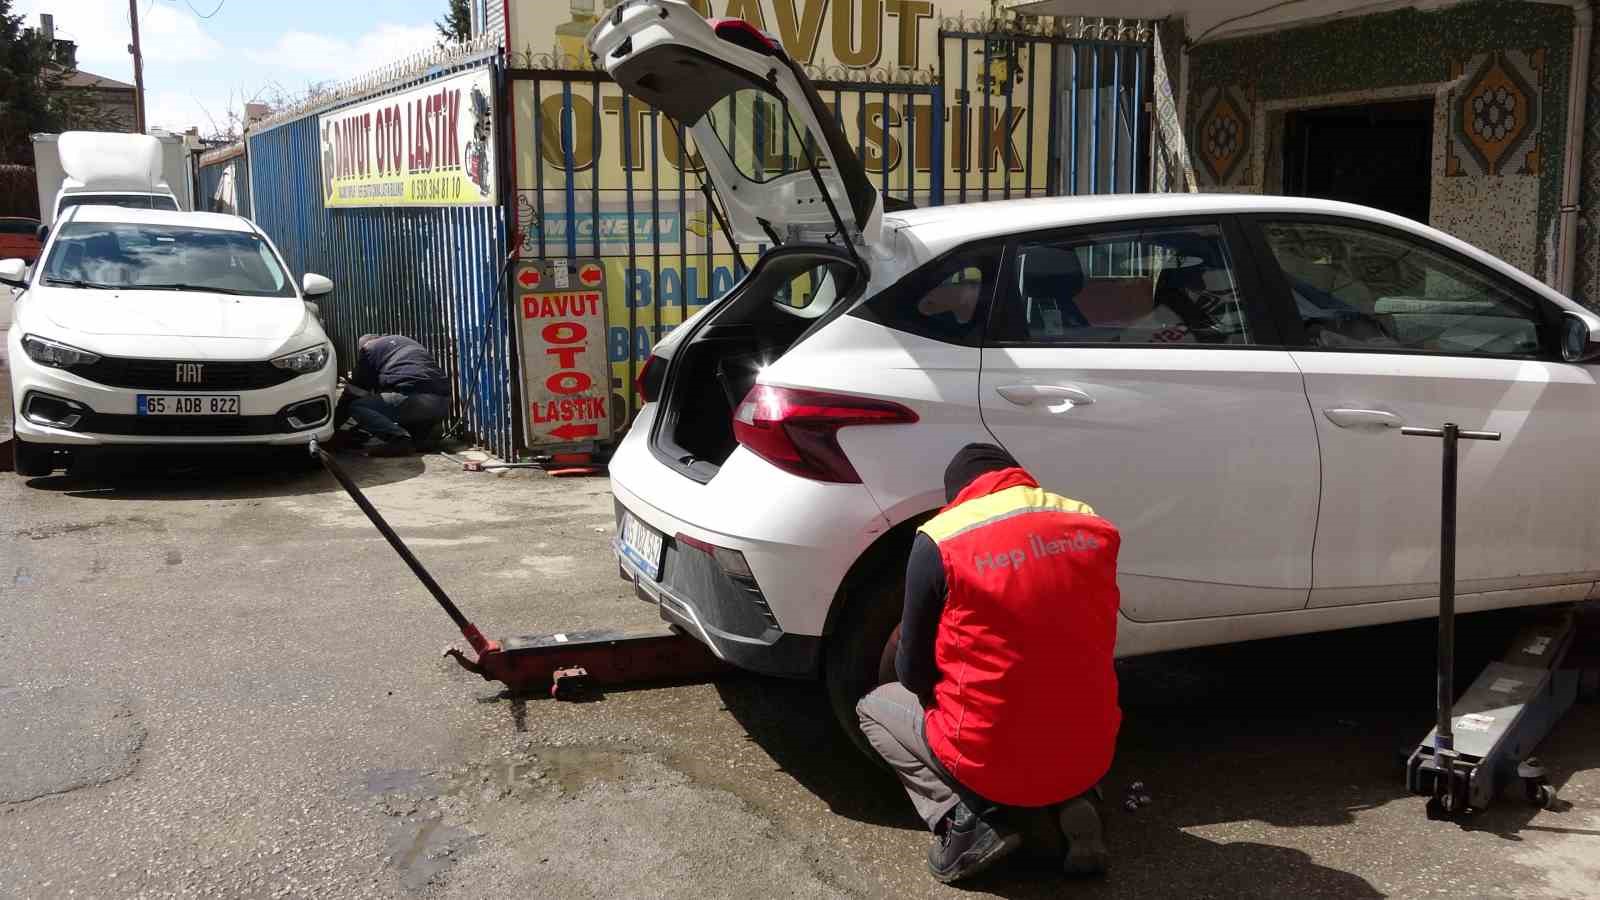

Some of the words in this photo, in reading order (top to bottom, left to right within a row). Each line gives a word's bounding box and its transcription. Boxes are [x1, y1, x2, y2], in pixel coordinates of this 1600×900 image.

[690, 0, 932, 69] VUT
[335, 112, 370, 180] DAVUT
[376, 104, 402, 178] OTO
[408, 86, 461, 175] LASTİK
[544, 219, 673, 236] MCHELIN
[624, 266, 750, 308] BALA
[523, 294, 600, 319] DAVUT
[175, 363, 205, 383] FIAT
[147, 398, 166, 413] 65
[176, 398, 203, 413] ADB
[210, 398, 237, 413] 822
[974, 551, 1027, 577] Hep
